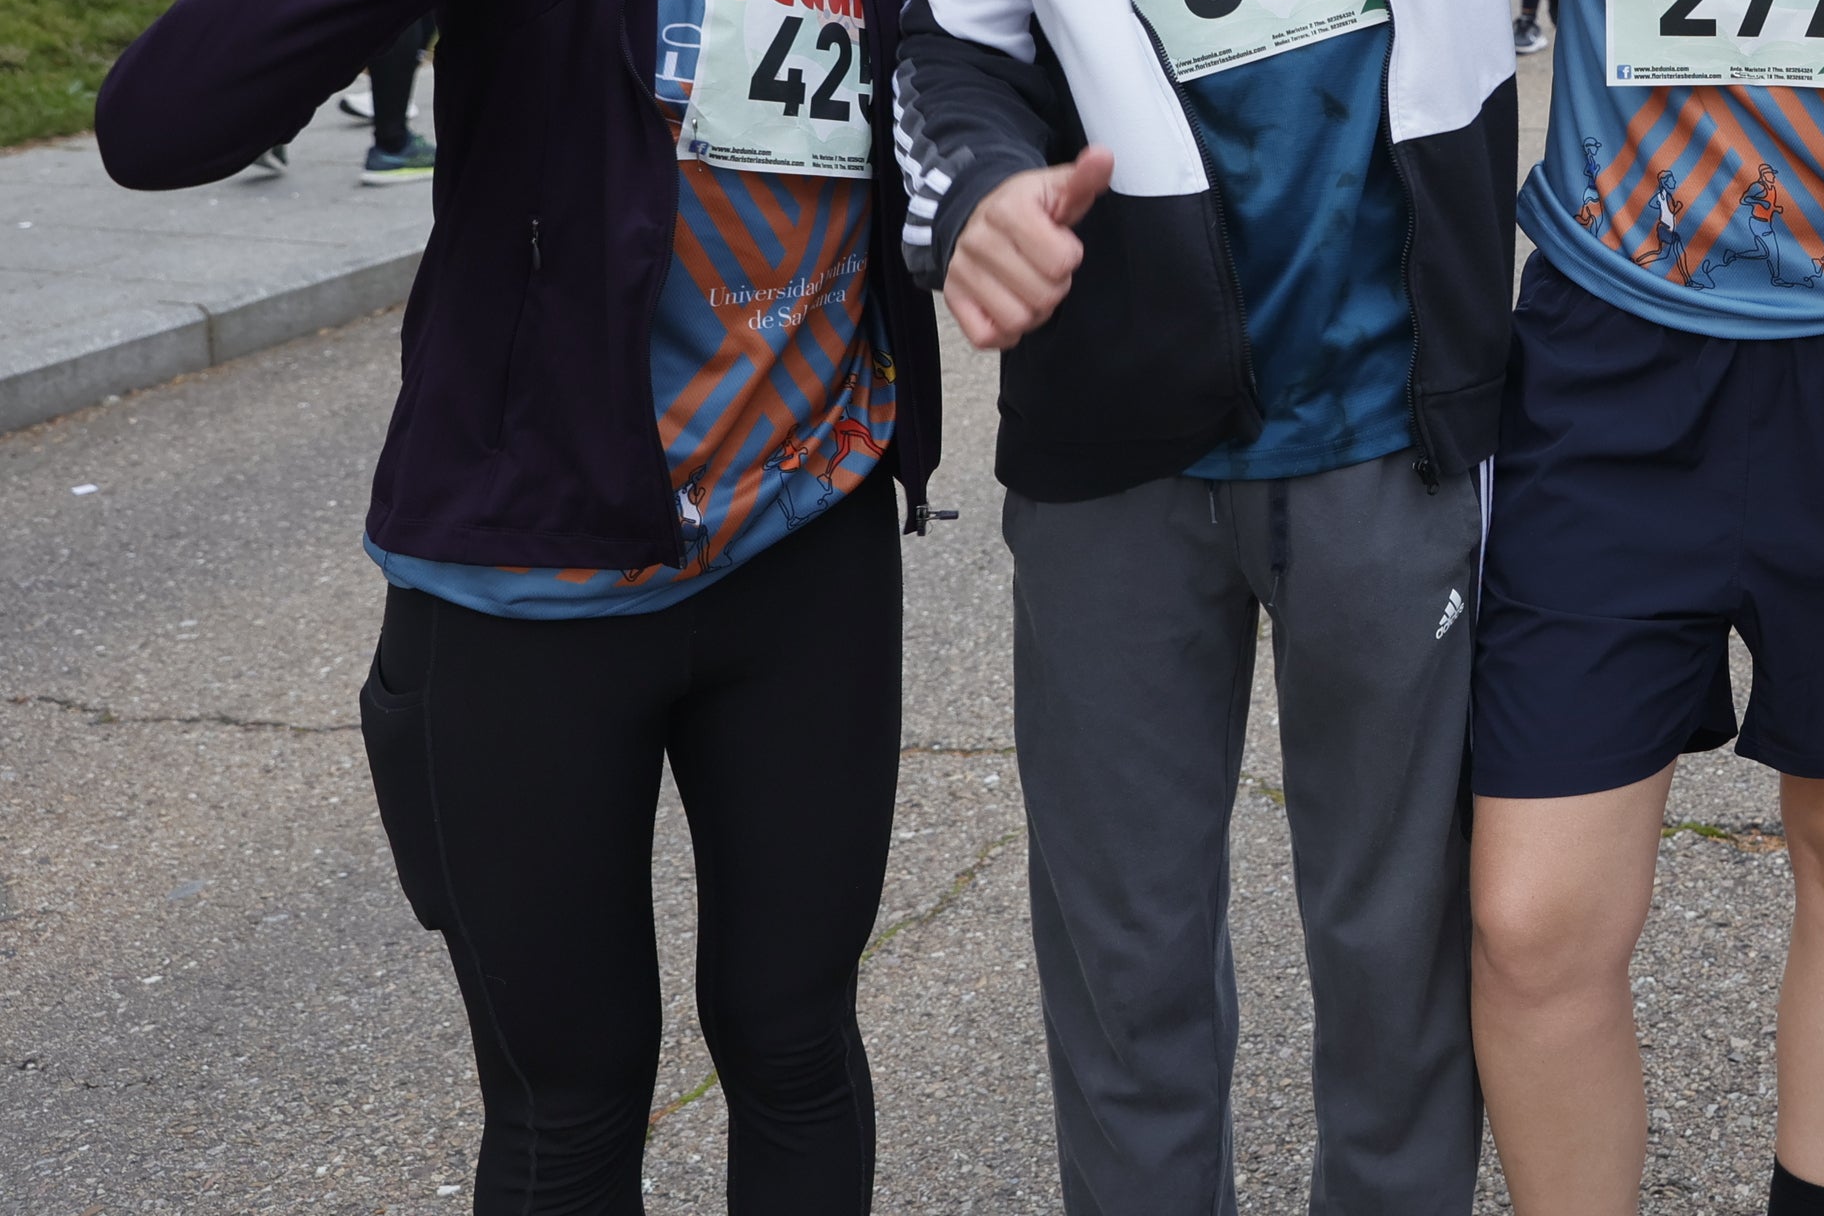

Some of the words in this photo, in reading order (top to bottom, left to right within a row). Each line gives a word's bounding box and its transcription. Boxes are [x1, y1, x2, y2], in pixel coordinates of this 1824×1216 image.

[1634, 65, 1689, 73] www.bedunia.com
[1634, 72, 1722, 80] www.floristeriasbedunia.com
[709, 272, 824, 308] Universidad
[748, 309, 775, 329] de
